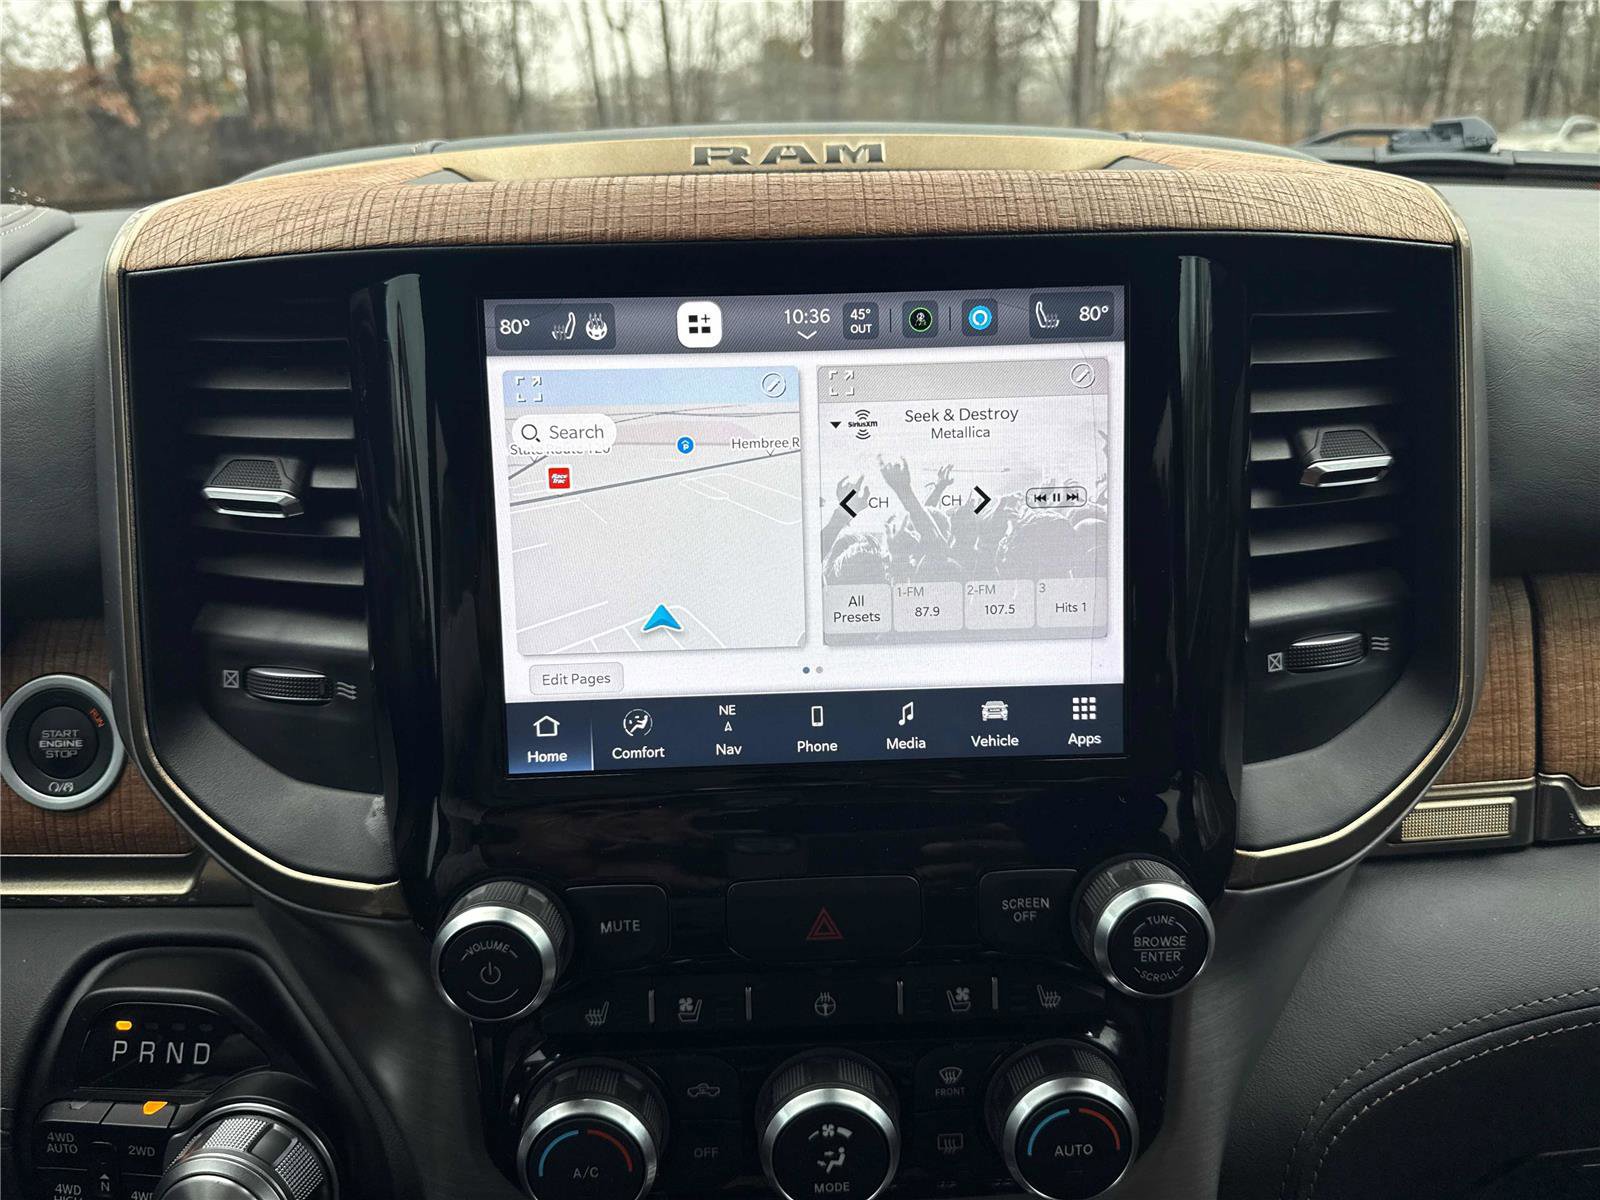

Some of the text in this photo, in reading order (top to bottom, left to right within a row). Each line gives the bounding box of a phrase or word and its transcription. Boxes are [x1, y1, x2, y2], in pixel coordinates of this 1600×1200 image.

[692, 142, 886, 167] RAM
[783, 308, 831, 325] 10:36
[850, 307, 872, 321] 45°
[1079, 305, 1109, 322] 80°
[499, 318, 531, 335] 80°
[850, 323, 872, 334] OUT
[904, 406, 1019, 424] Seek & Destroy
[549, 423, 604, 440] Search
[931, 426, 991, 440] Metallica
[731, 437, 790, 449] Hembree
[868, 497, 889, 509] CH
[941, 495, 962, 507] CH
[896, 585, 925, 598] 1-FM
[967, 584, 996, 596] 2-FM
[1039, 582, 1046, 593] 3
[848, 595, 865, 608] All
[1055, 601, 1087, 613] Hits 1
[914, 606, 941, 618] 87.9
[984, 604, 1016, 616] 107.5
[833, 611, 881, 623] Presets
[542, 673, 612, 688] Edit Pages
[719, 704, 737, 716] NE
[41, 729, 80, 738] START
[1068, 732, 1102, 747] Apps
[39, 739, 84, 748] ENGINE
[797, 739, 838, 753] Phone
[886, 737, 926, 750] Media
[971, 734, 1020, 748] Vehicle
[45, 749, 79, 759] STOP
[612, 746, 665, 760] Comfort
[715, 743, 742, 756] Nav
[527, 750, 568, 763] Home
[1001, 897, 1050, 910] SCREEN
[1013, 910, 1037, 923] OFF
[1147, 914, 1176, 927] TUNE
[600, 919, 641, 933] MUTE
[1133, 935, 1187, 947] BROWSE
[465, 940, 511, 956] VOLUME
[1140, 950, 1181, 963] ENTER
[1139, 968, 1180, 983] SCROLL
[935, 1087, 966, 1097] FRONT
[47, 1131, 75, 1143] 4WD
[46, 1143, 79, 1154] AUTO
[128, 1144, 156, 1157] 2WD
[693, 1146, 719, 1159] OFF
[1054, 1143, 1094, 1158] AUTO
[573, 1165, 600, 1180] A/C
[54, 1183, 82, 1196] 4WD
[814, 1180, 851, 1195] MODE
